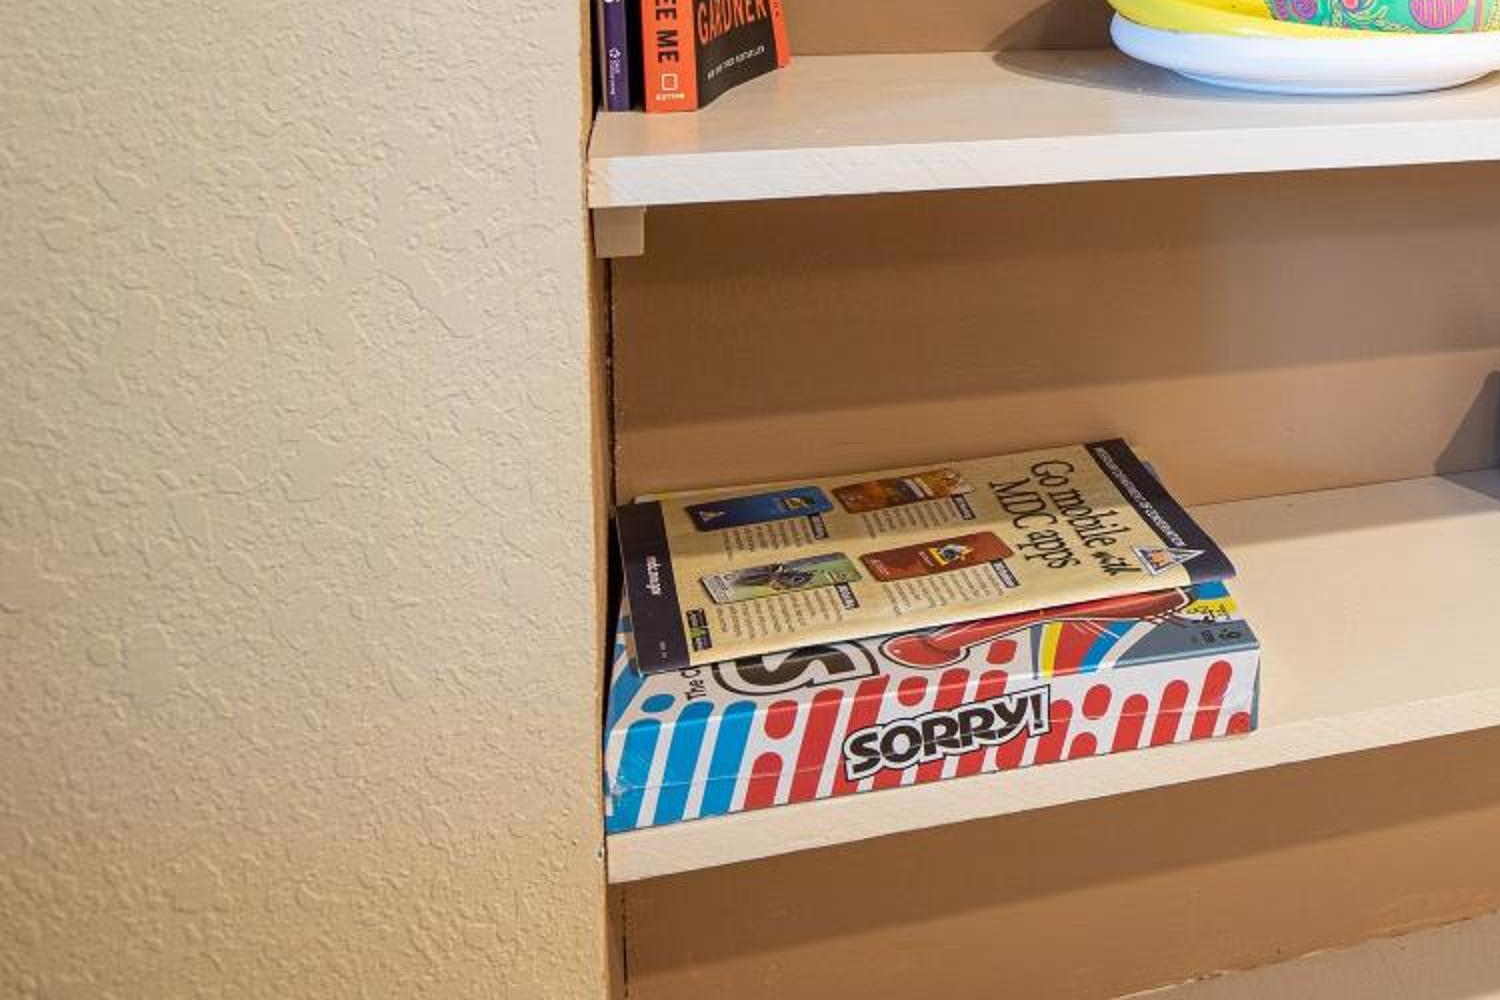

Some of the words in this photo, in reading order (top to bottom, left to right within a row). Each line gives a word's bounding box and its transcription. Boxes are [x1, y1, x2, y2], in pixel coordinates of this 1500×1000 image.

[656, 26, 680, 64] ME
[1030, 459, 1075, 489] Go
[988, 477, 1058, 530] MDC
[1048, 487, 1131, 548] mobile
[1016, 526, 1081, 570] apps
[683, 679, 707, 701] The
[847, 690, 1047, 777] SORRY!
